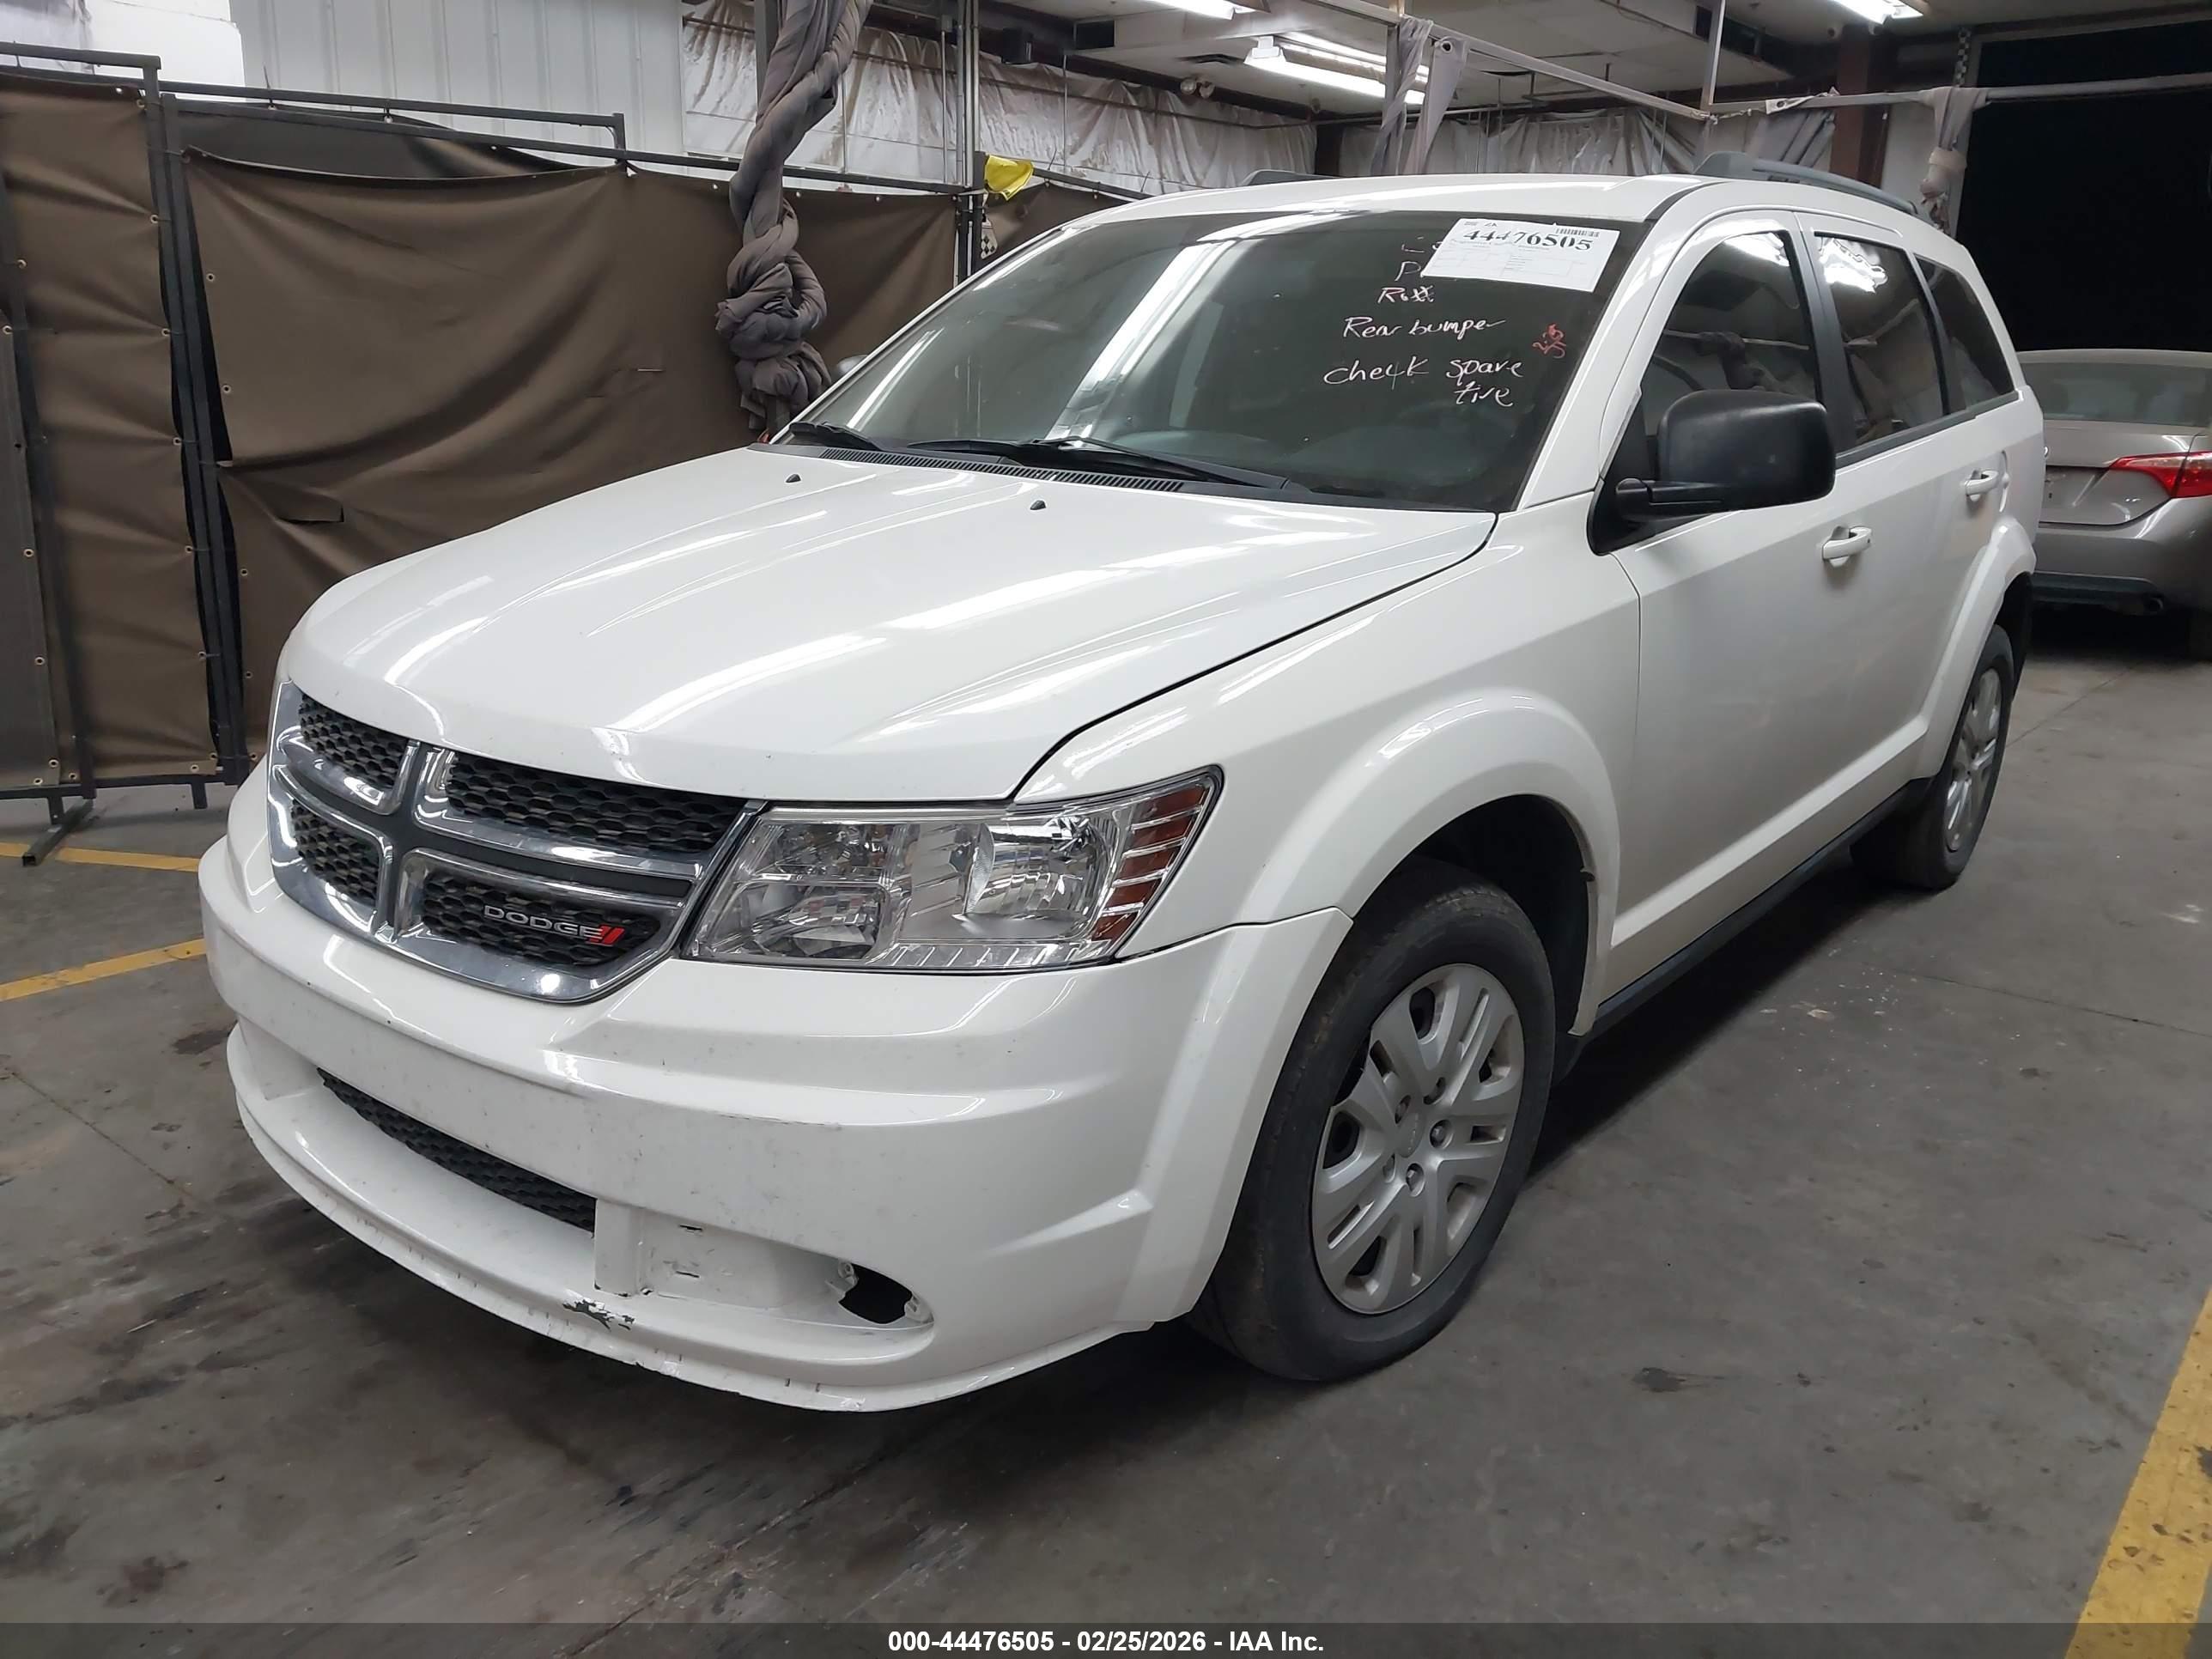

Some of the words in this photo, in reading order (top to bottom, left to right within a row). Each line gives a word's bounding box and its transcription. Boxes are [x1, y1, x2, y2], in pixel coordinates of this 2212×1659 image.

[1463, 230, 1593, 251] 44476505
[1343, 317, 1401, 338] Rear
[1409, 319, 1506, 340] bumper
[483, 905, 603, 941] DODGE
